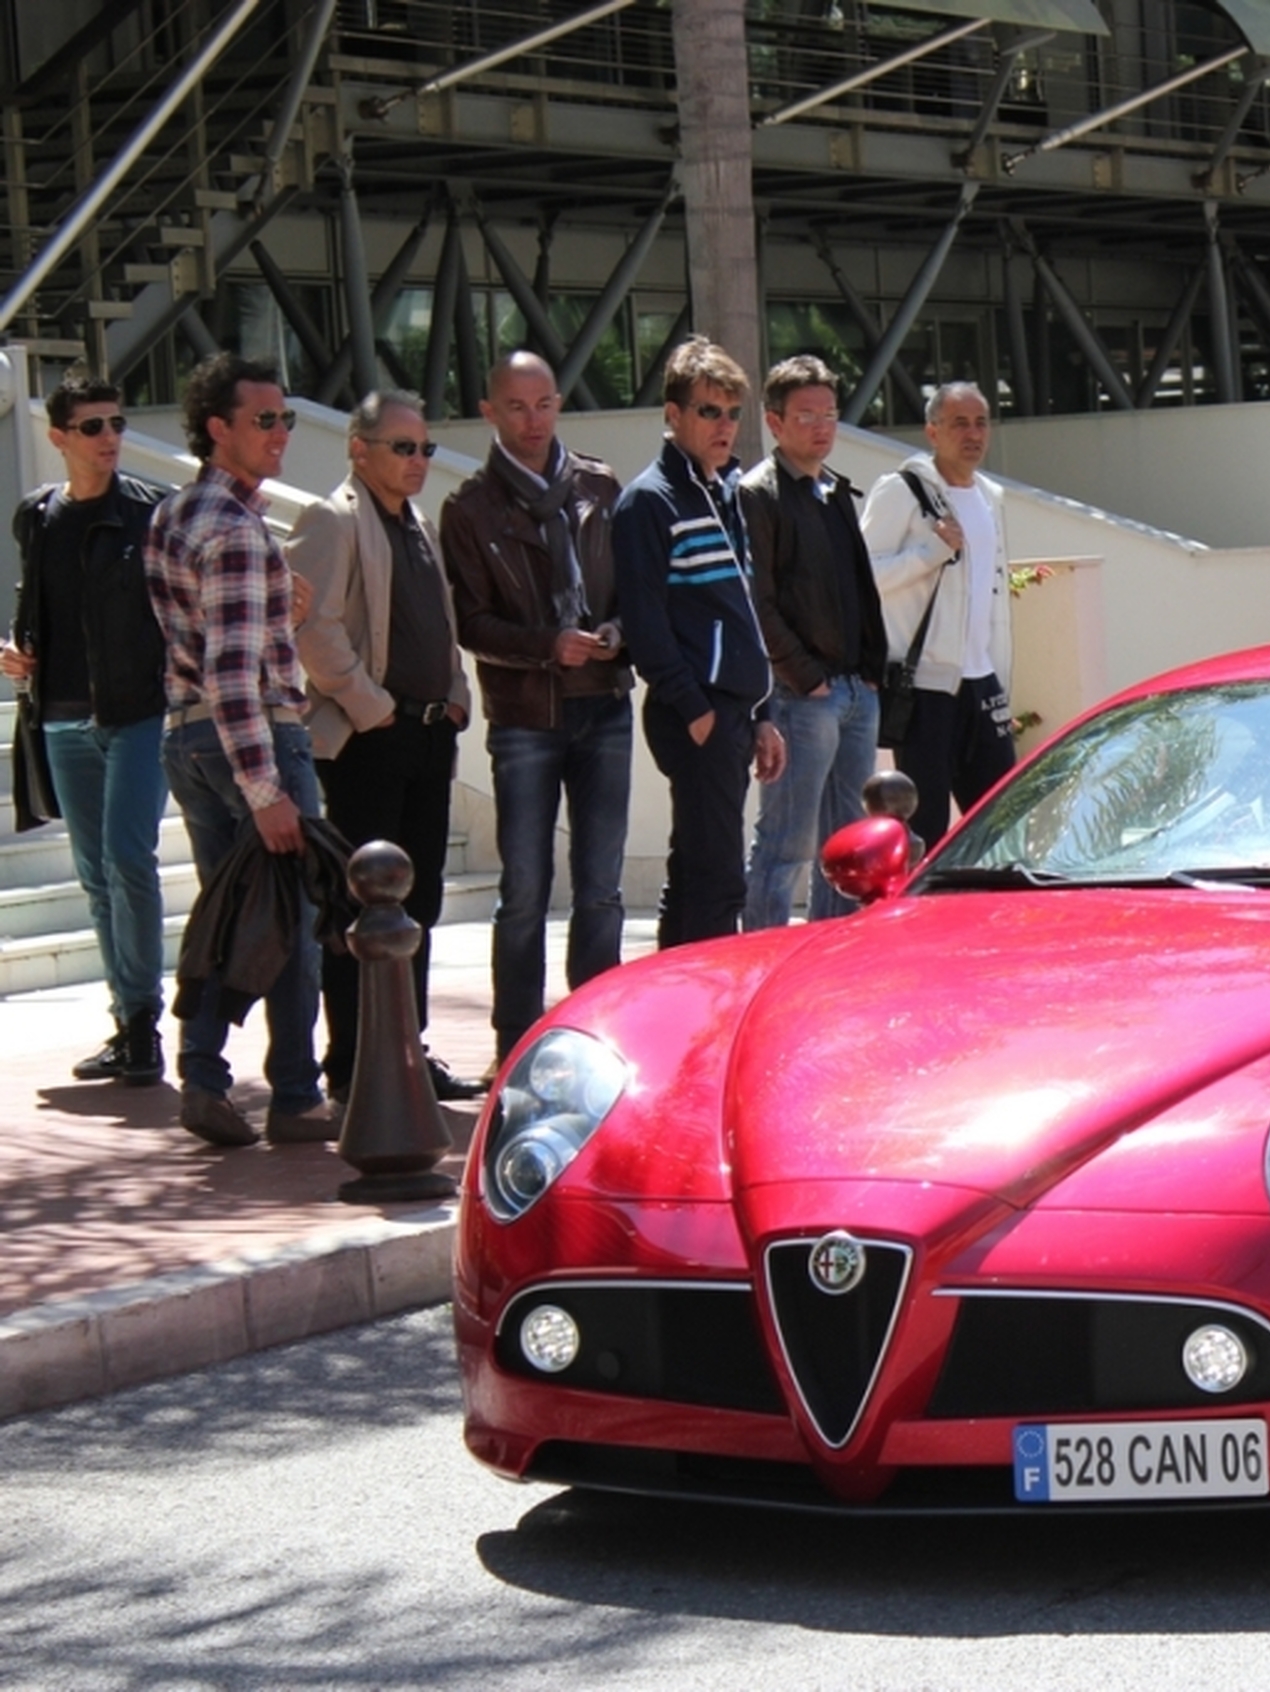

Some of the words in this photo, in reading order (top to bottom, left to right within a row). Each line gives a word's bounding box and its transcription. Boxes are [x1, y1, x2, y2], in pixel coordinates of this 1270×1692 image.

[1023, 1467, 1040, 1491] F
[1054, 1436, 1115, 1487] 528
[1128, 1433, 1208, 1485] CAN
[1221, 1432, 1262, 1482] 06
